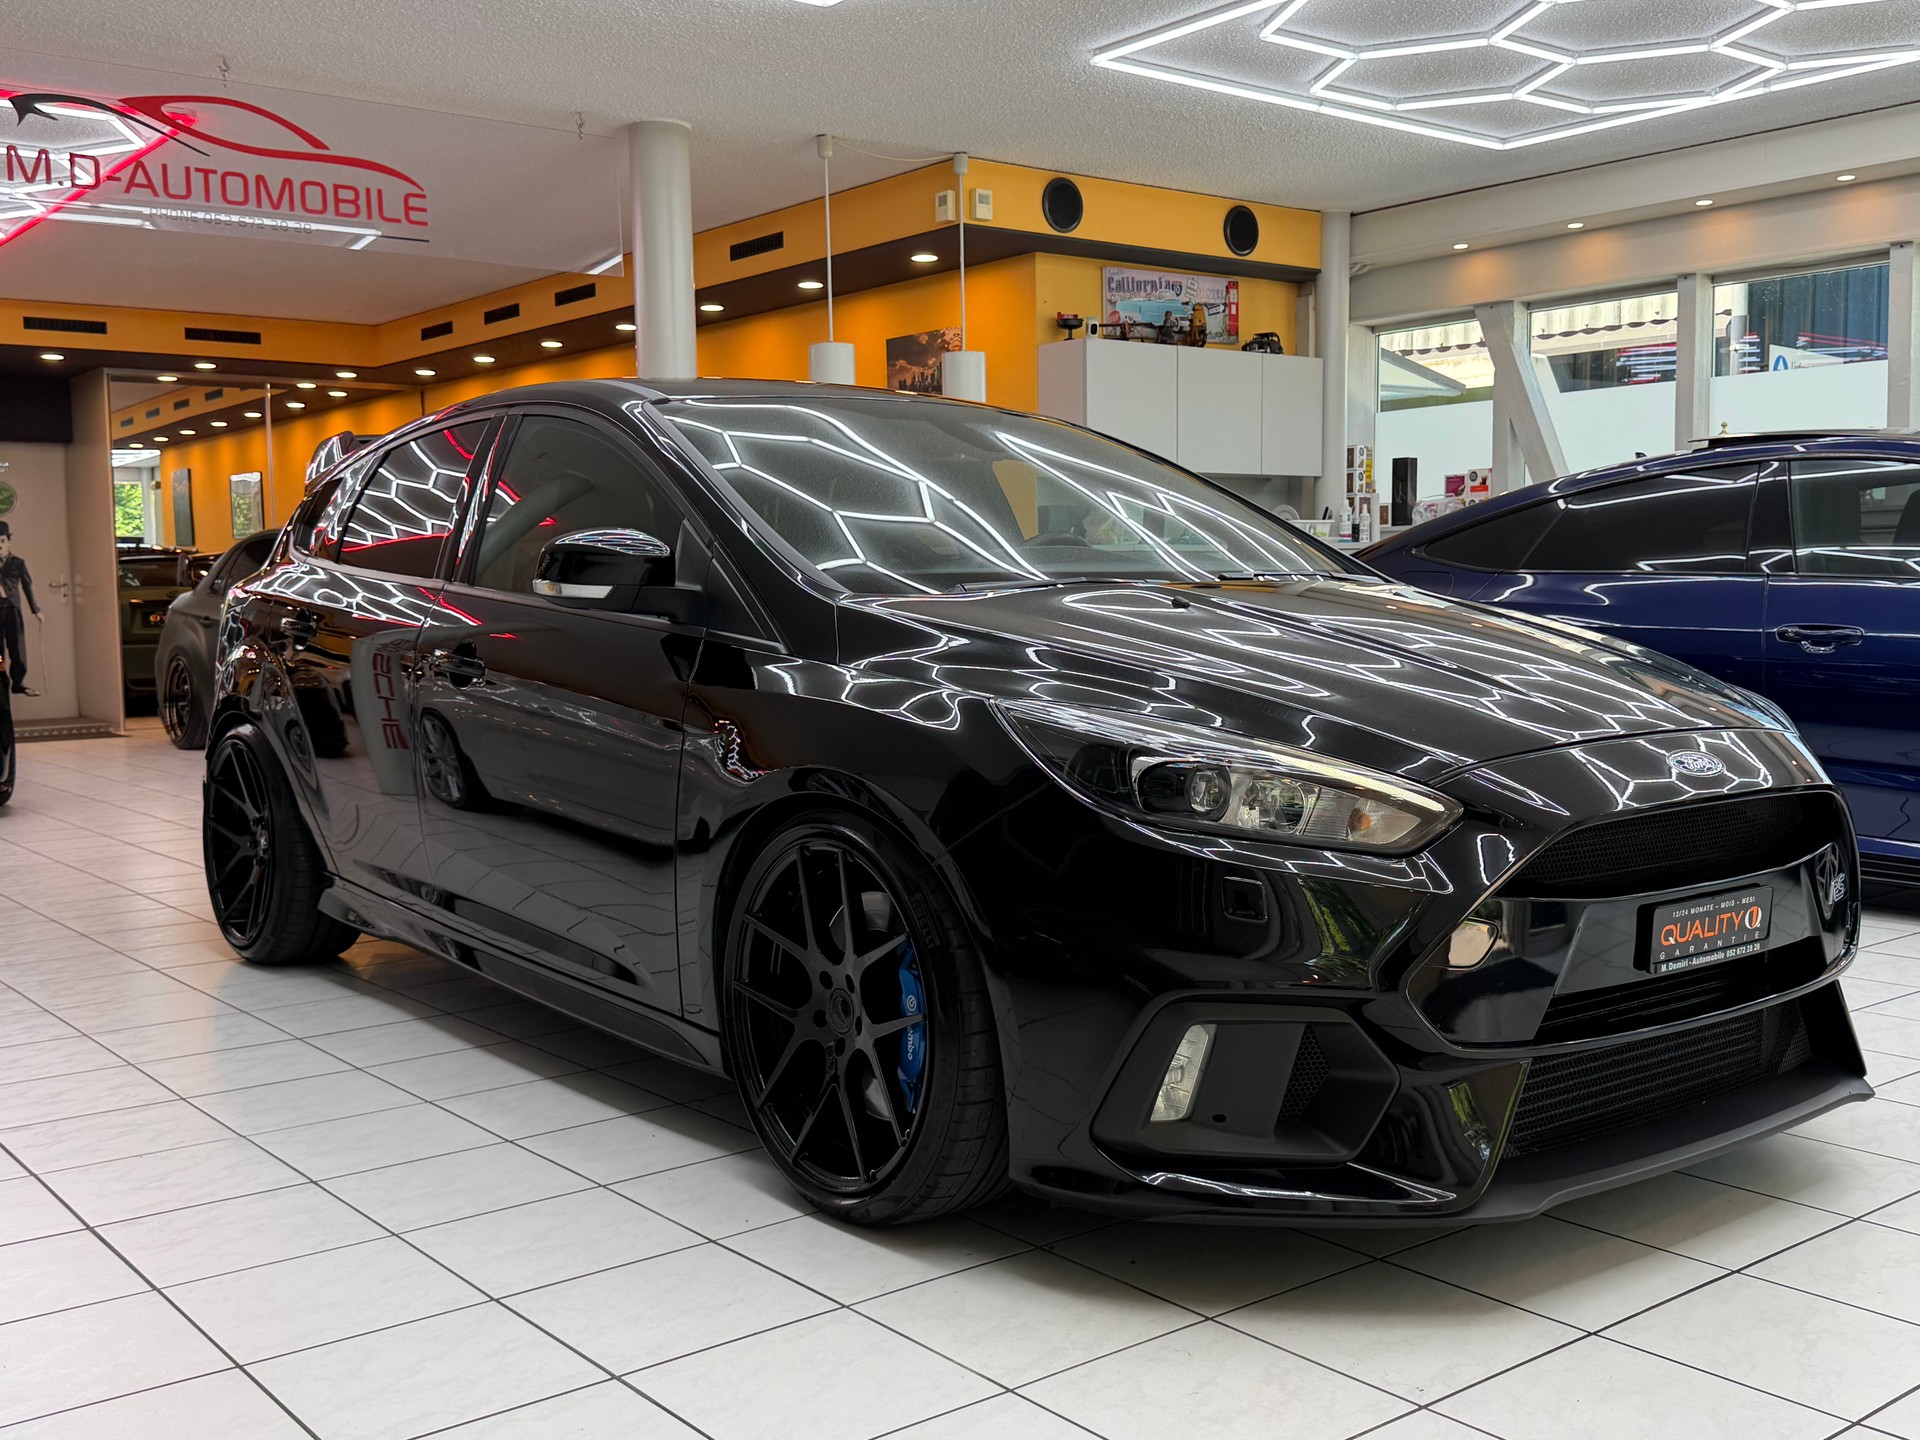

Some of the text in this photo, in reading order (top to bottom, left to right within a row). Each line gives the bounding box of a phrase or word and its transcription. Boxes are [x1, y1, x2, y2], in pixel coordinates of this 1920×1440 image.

[149, 208, 198, 223] PHONE
[204, 212, 233, 226] 052
[1108, 276, 1172, 293] California
[1672, 909, 1689, 918] 12/24
[1690, 904, 1714, 915] MONATE
[1720, 899, 1735, 909] MOIS
[1661, 910, 1744, 946] QUALITY
[1660, 931, 1760, 960] GARANTIE
